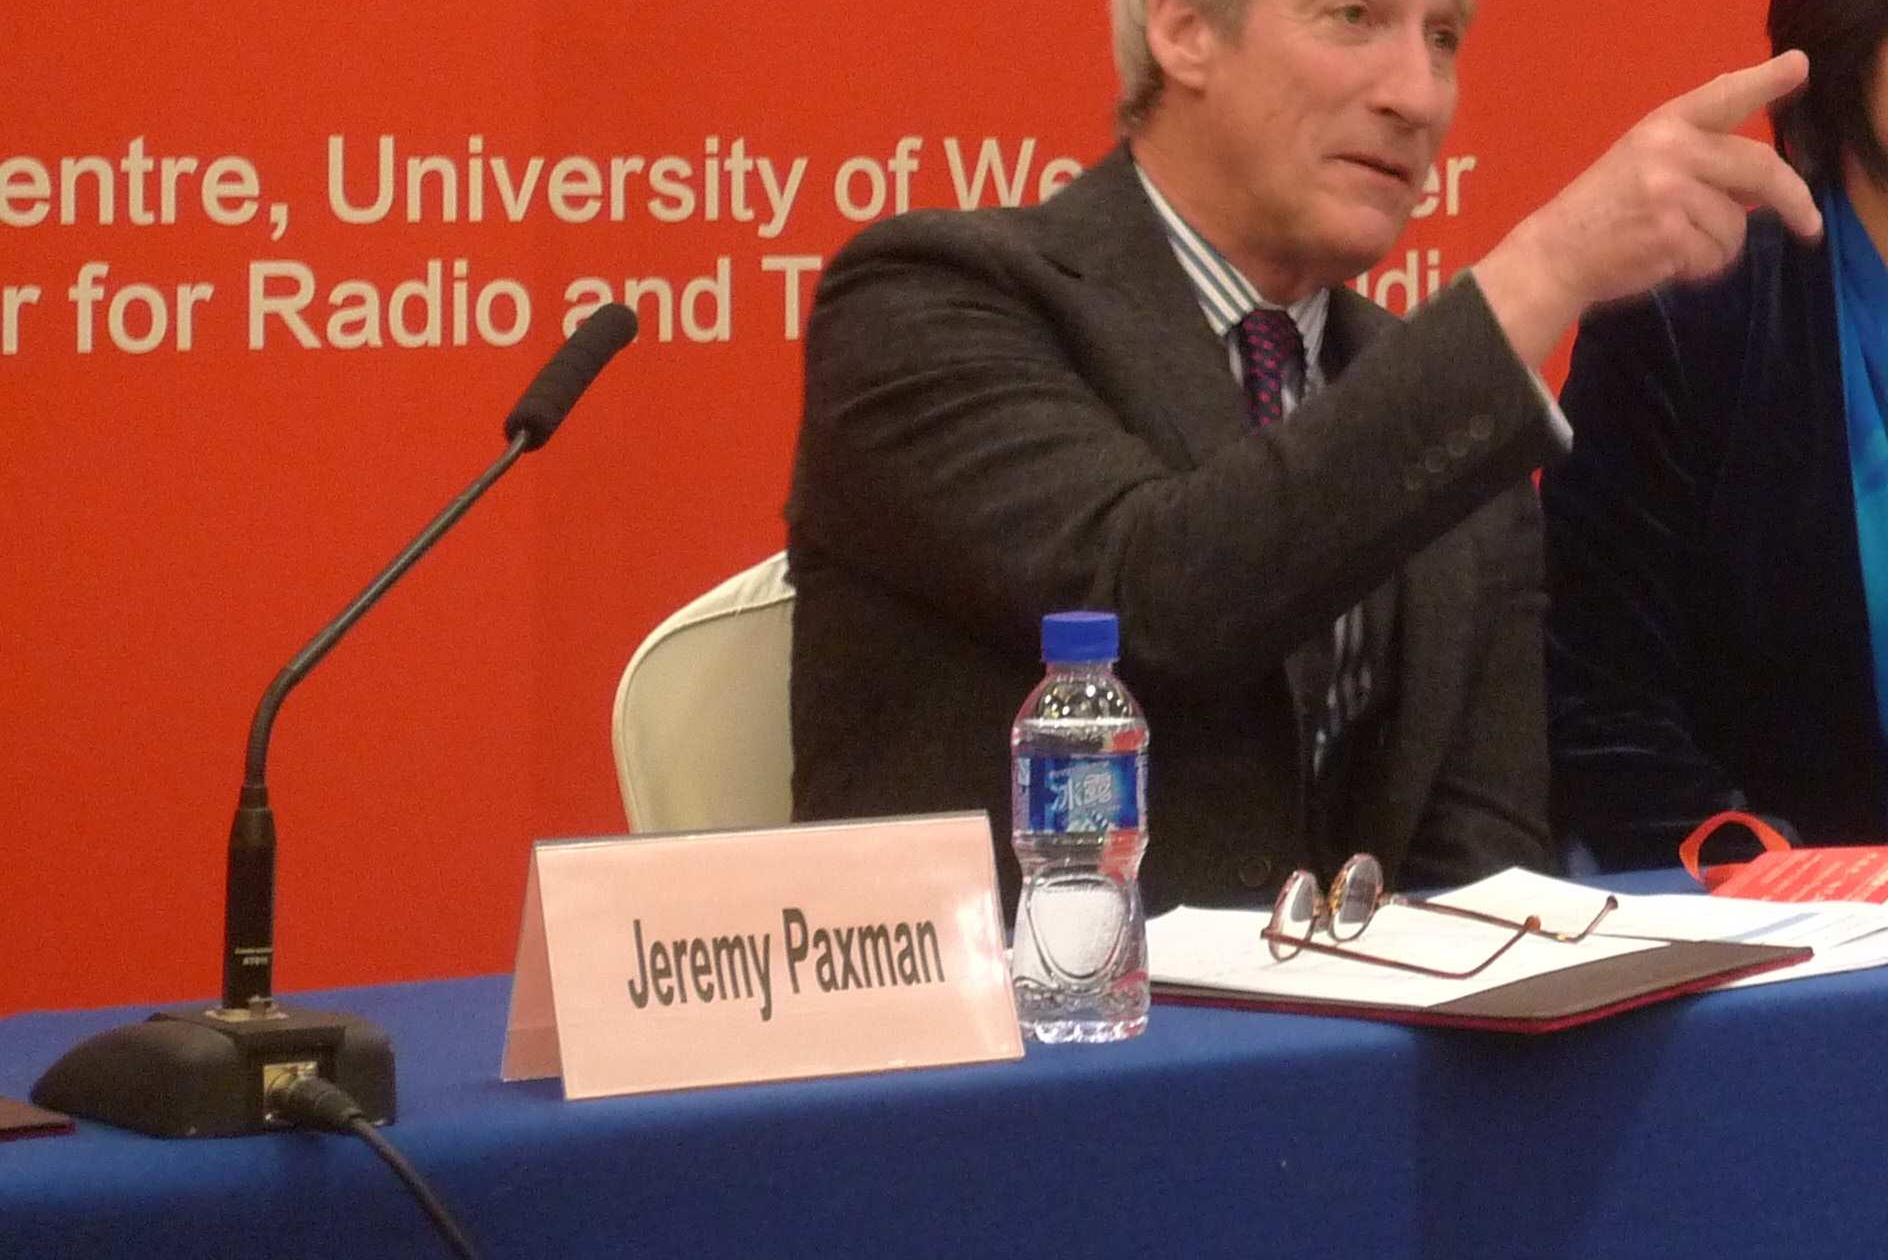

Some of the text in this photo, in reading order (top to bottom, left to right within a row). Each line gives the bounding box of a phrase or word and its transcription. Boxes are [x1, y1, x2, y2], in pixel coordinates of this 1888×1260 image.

[0, 136, 289, 241] entre,
[328, 135, 808, 239] University
[834, 136, 923, 215] of
[68, 262, 214, 354] for
[249, 258, 531, 350] Radio
[562, 256, 731, 342] and
[627, 907, 945, 1022] Jeremy Paxman
